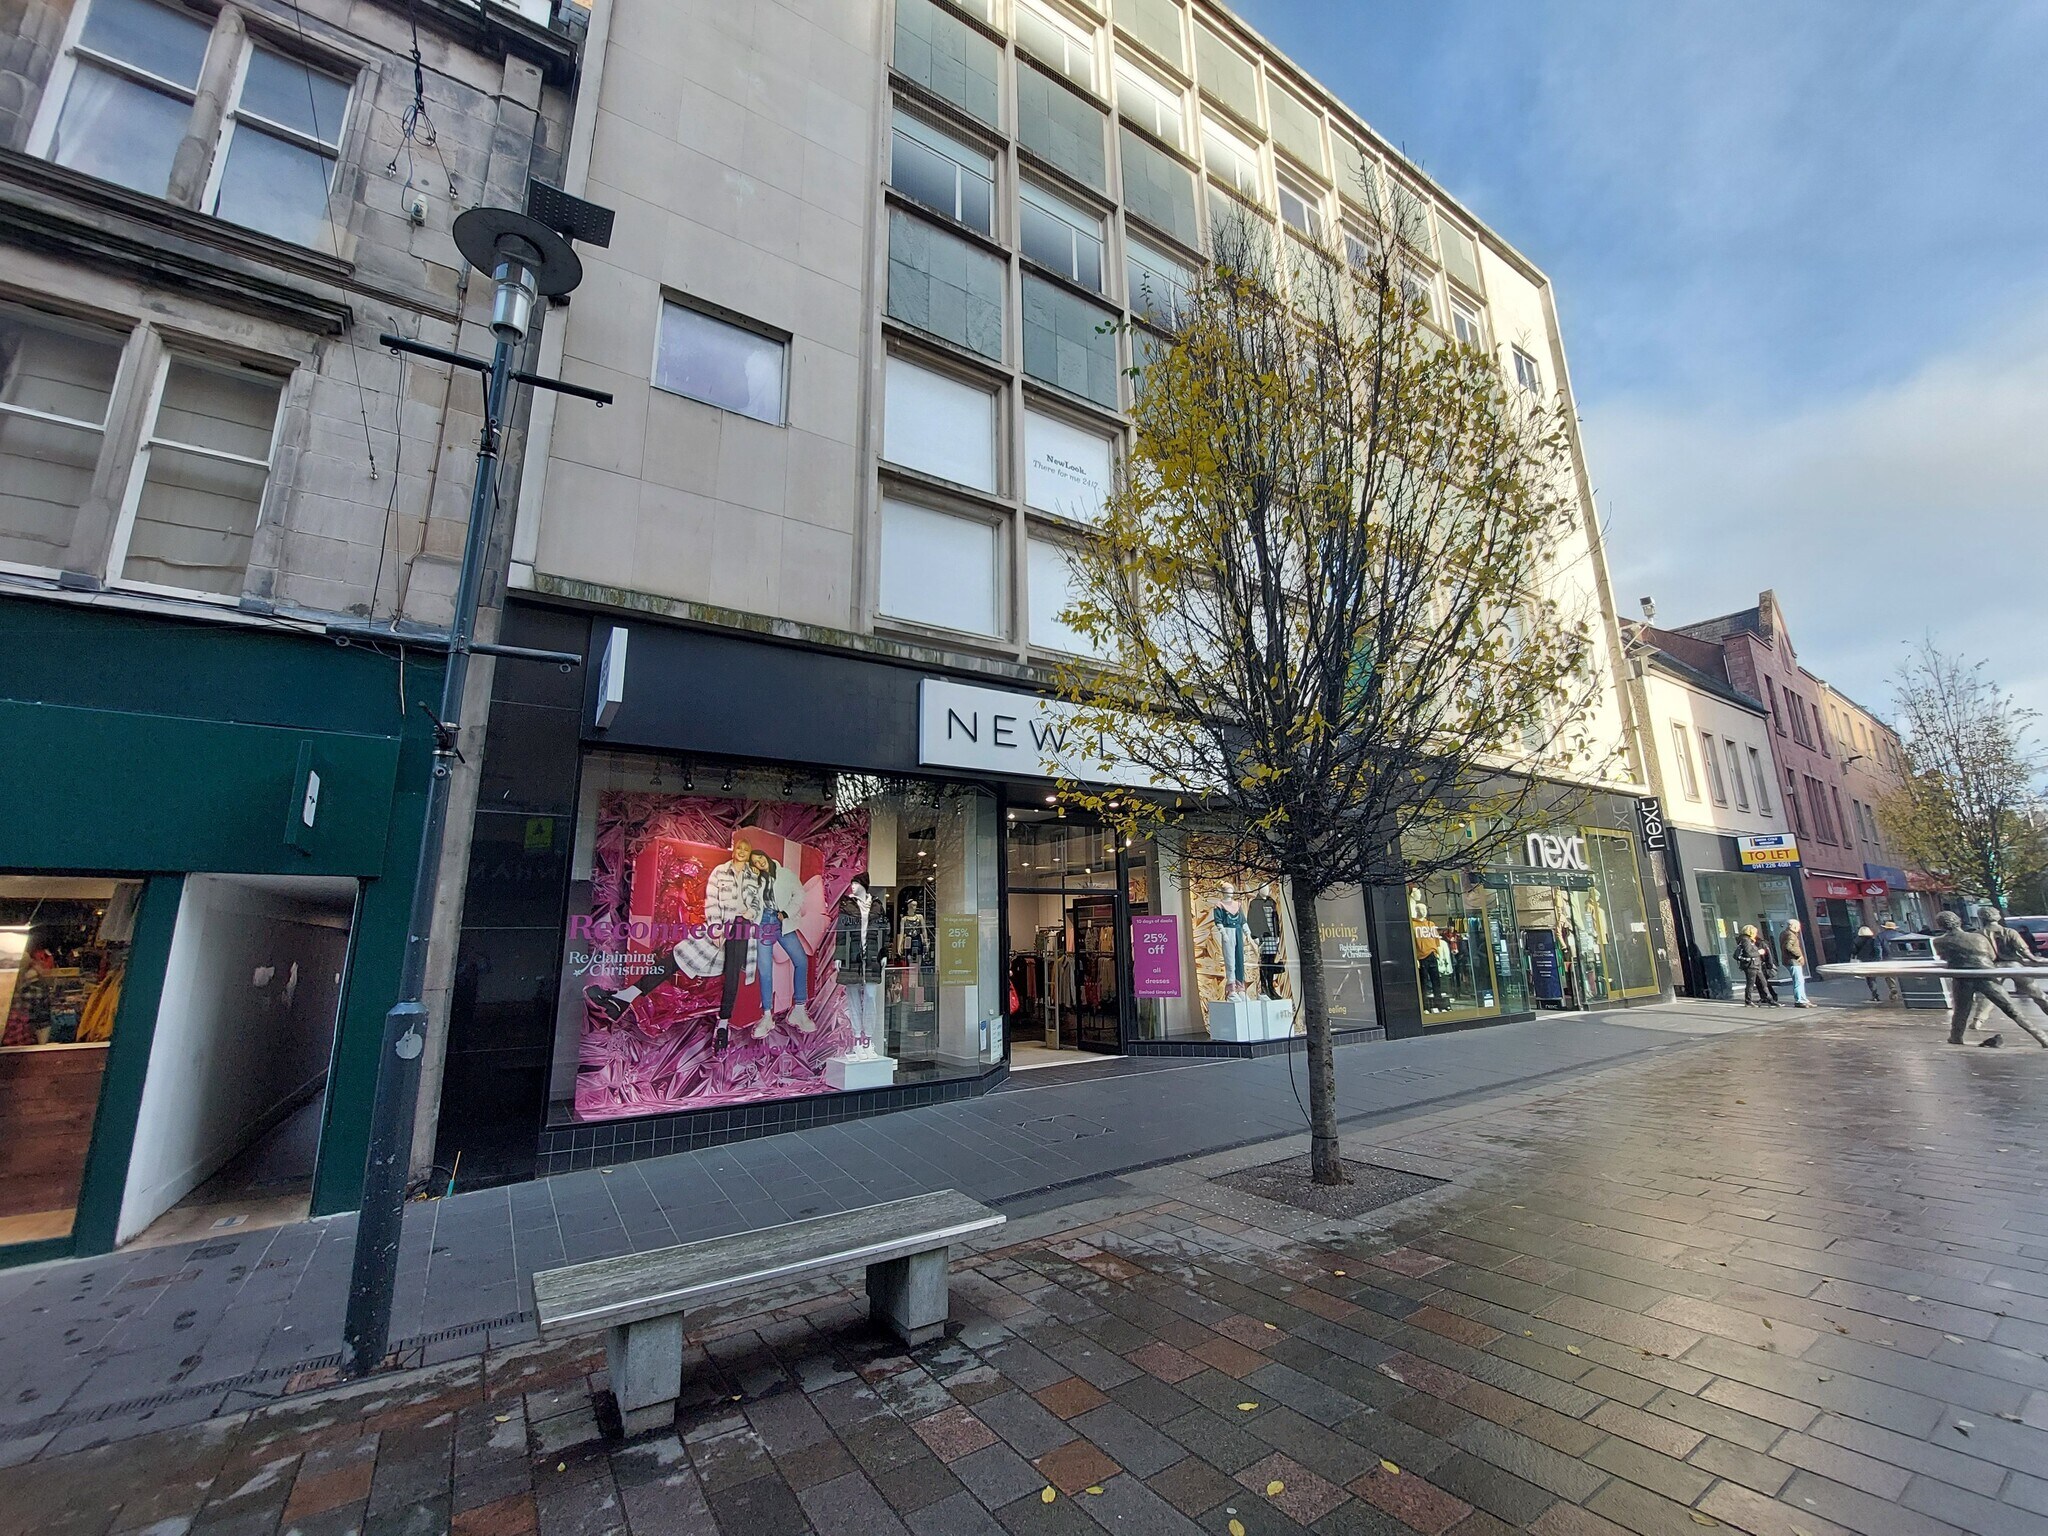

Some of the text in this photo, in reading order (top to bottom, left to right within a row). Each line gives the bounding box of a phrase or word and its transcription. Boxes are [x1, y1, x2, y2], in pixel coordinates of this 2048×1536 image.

[1033, 460, 1056, 473] There
[1057, 468, 1068, 478] for
[1069, 475, 1081, 484] me
[1046, 454, 1087, 475] NewLook.
[948, 707, 1068, 754] NEW
[1642, 800, 1665, 850] next
[1526, 832, 1589, 870] next
[1747, 849, 1790, 861] TO LET
[568, 914, 780, 946] Reconnecting
[948, 928, 969, 937] 25%
[1143, 933, 1169, 943] 25%
[951, 938, 967, 948] off
[1147, 944, 1165, 955] off
[589, 963, 665, 977] Christmas
